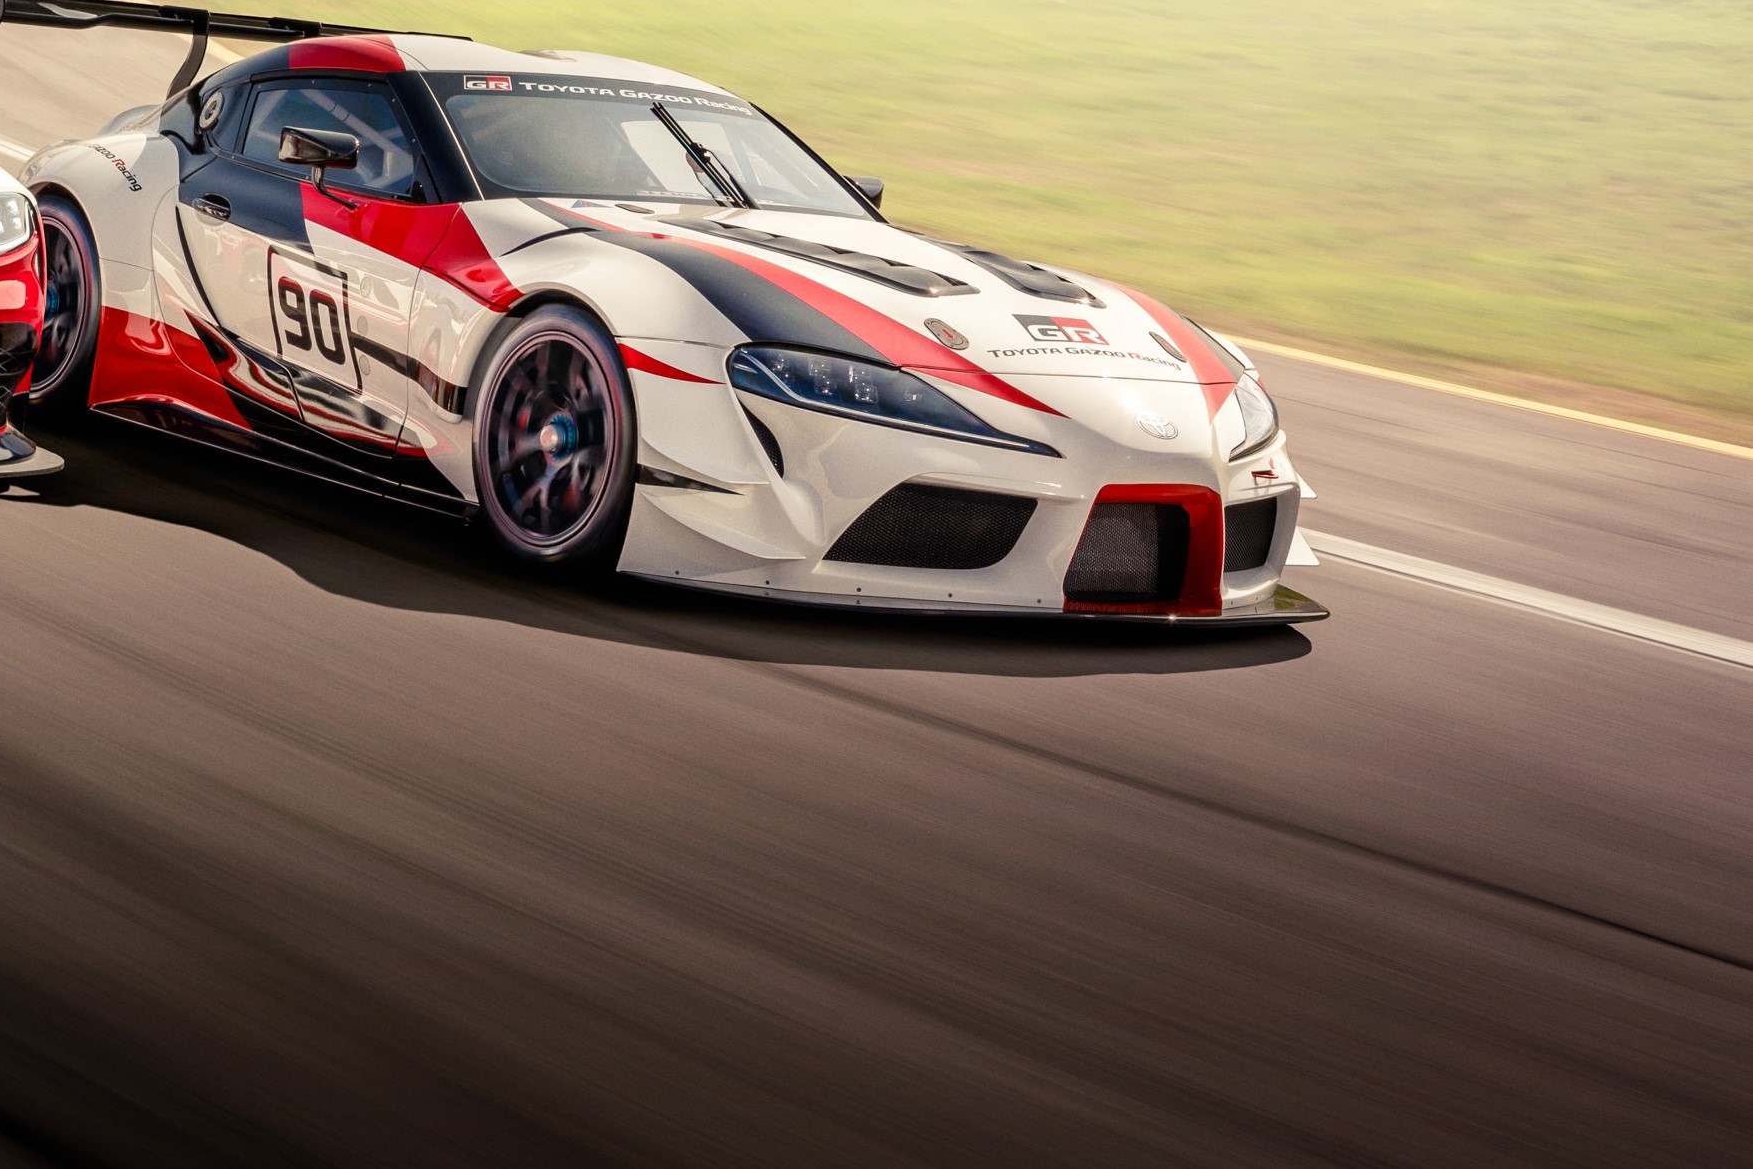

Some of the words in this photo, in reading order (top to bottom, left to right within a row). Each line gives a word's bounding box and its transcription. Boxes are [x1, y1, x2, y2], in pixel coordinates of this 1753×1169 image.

[466, 80, 511, 90] GR
[518, 81, 616, 96] TOYOTA
[619, 88, 693, 104] GAZOO
[693, 96, 753, 116] Racing
[111, 158, 143, 192] Racing
[278, 276, 346, 365] 90
[1026, 324, 1107, 345] GR
[987, 347, 1063, 358] TOYOTA
[1065, 347, 1126, 359] GAZOO
[1127, 352, 1182, 371] Racing
